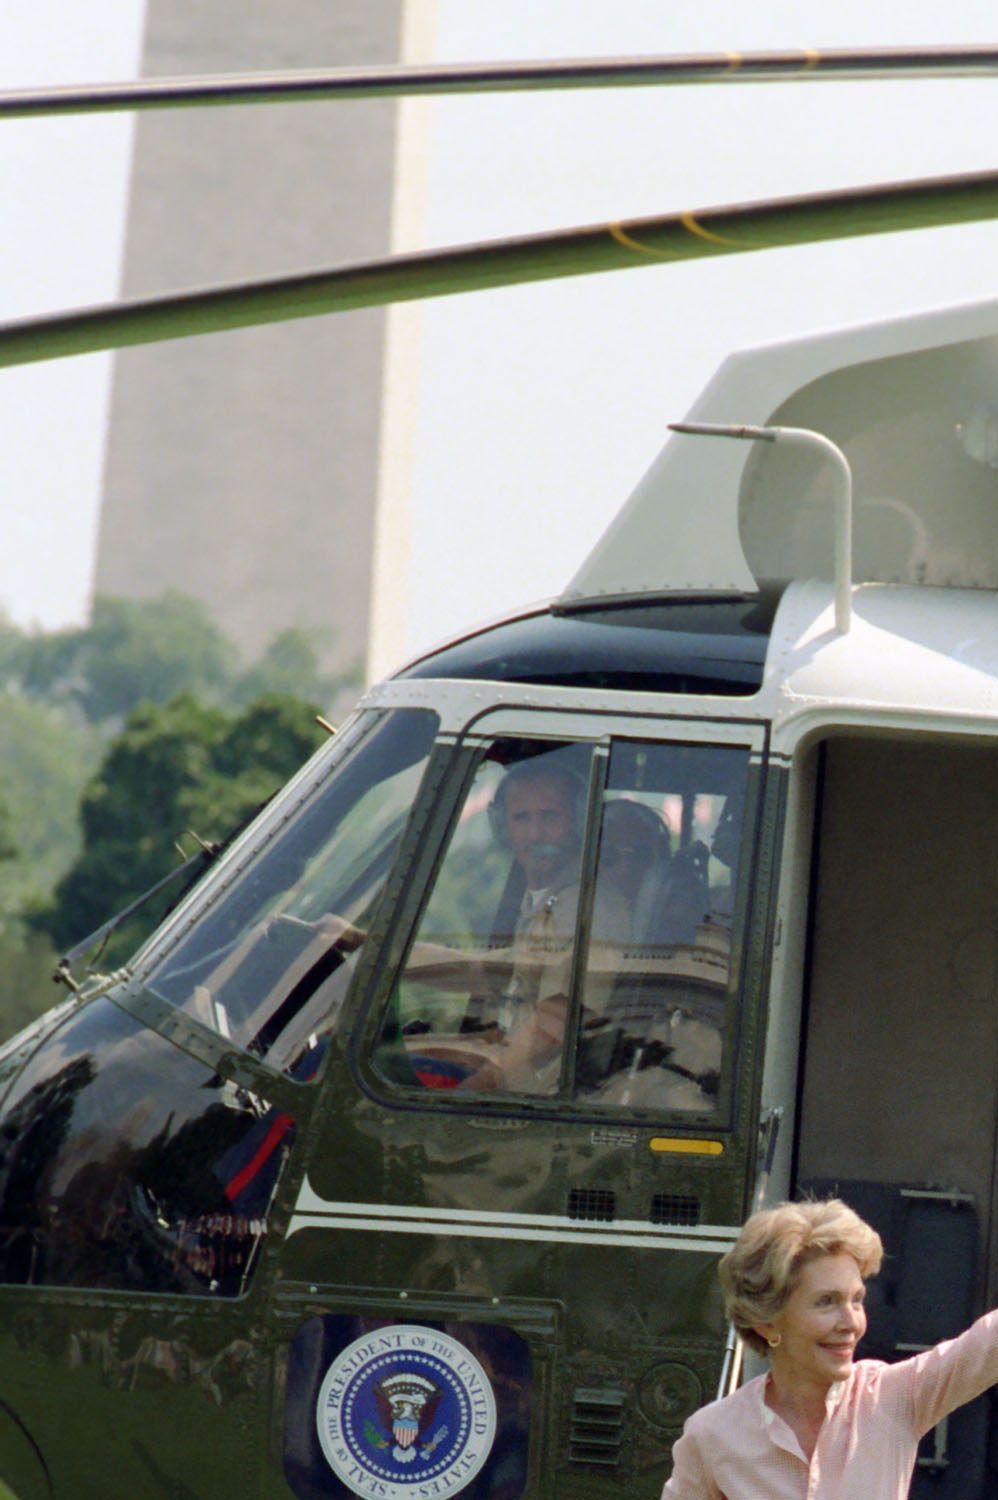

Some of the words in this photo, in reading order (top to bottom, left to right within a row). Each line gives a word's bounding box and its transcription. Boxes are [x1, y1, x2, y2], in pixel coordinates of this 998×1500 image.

[411, 1336, 426, 1347] OF
[432, 1342, 457, 1360] THE
[327, 1334, 405, 1409] PRESIDENT
[457, 1360, 488, 1435] UNITED
[328, 1416, 340, 1441] THE
[335, 1447, 349, 1462] OF
[348, 1461, 389, 1497] SEAL
[418, 1449, 477, 1498] STATES
